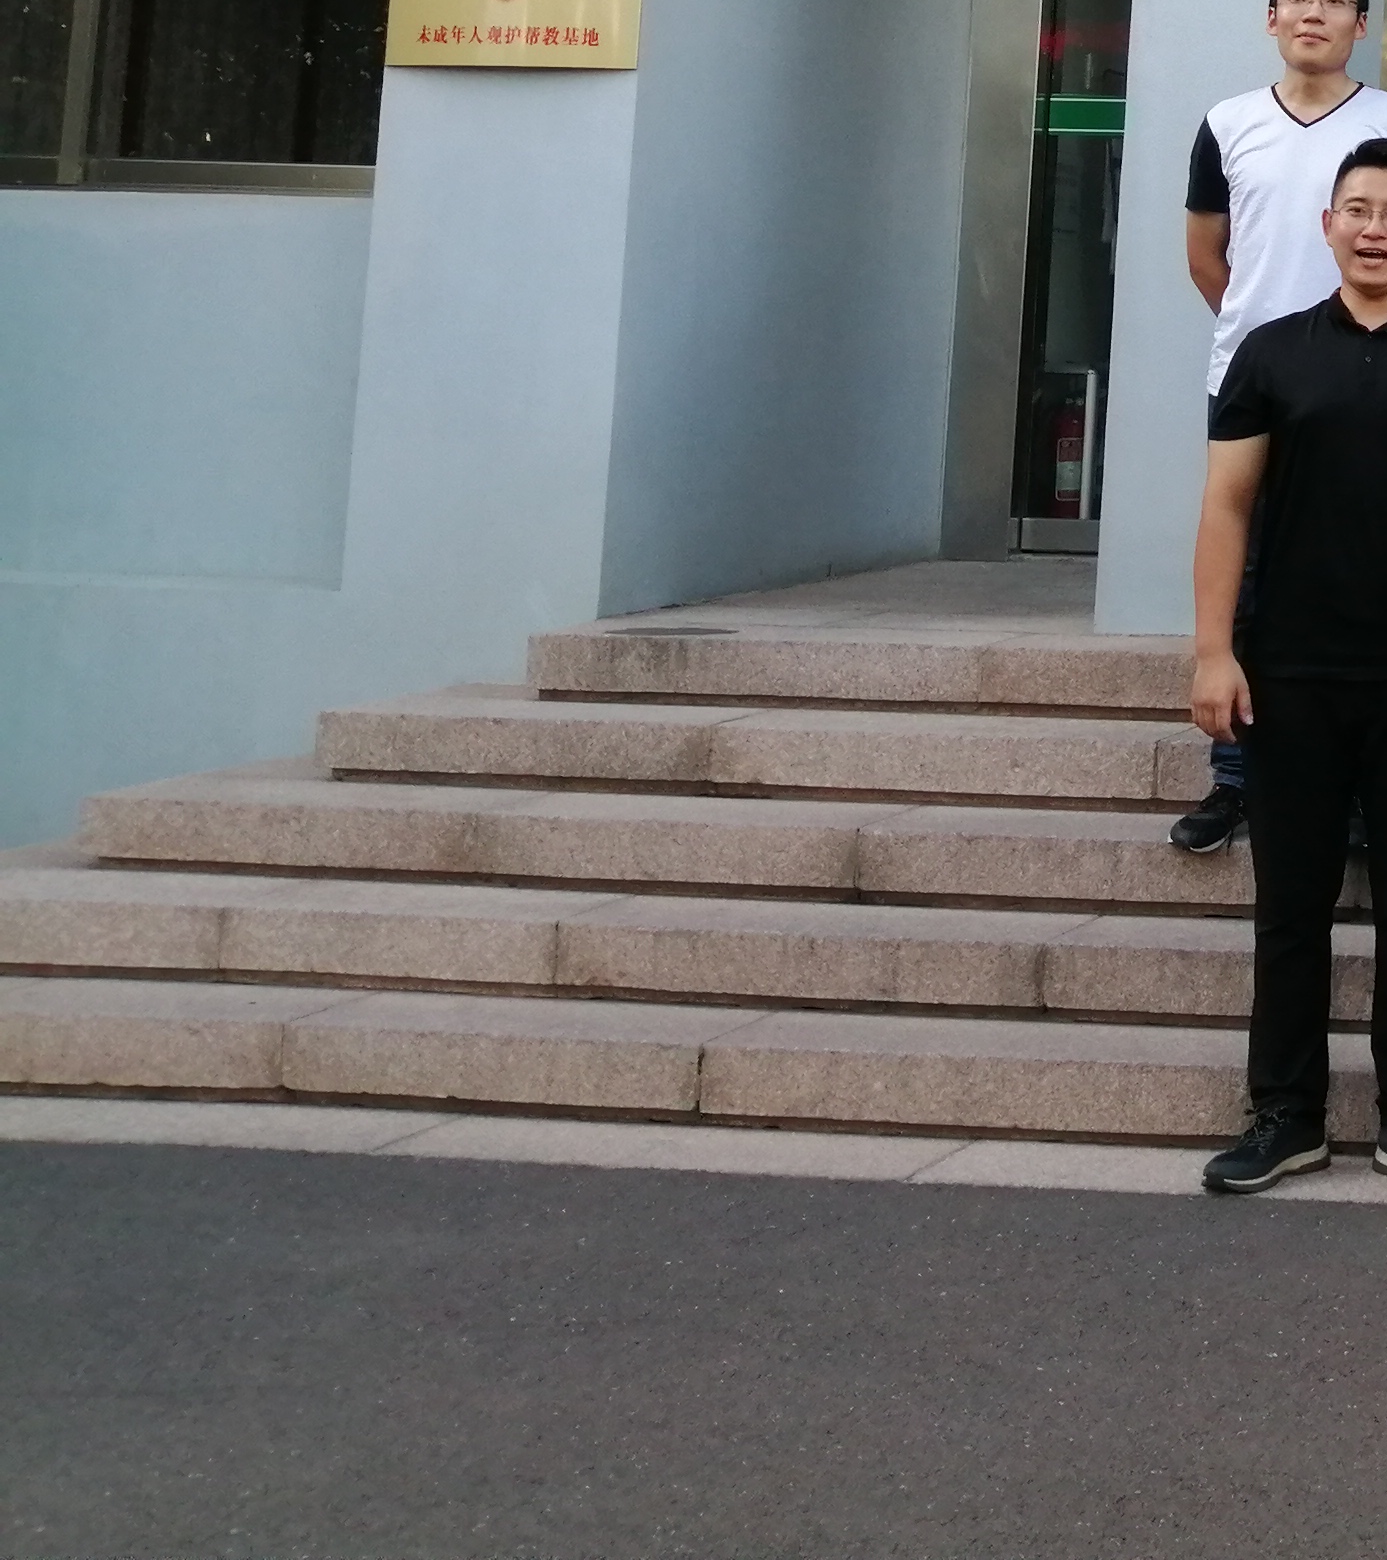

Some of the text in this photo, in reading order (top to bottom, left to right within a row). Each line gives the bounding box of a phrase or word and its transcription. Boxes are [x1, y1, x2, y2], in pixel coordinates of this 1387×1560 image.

[416, 24, 600, 47] 未成年人观护帮教基地
